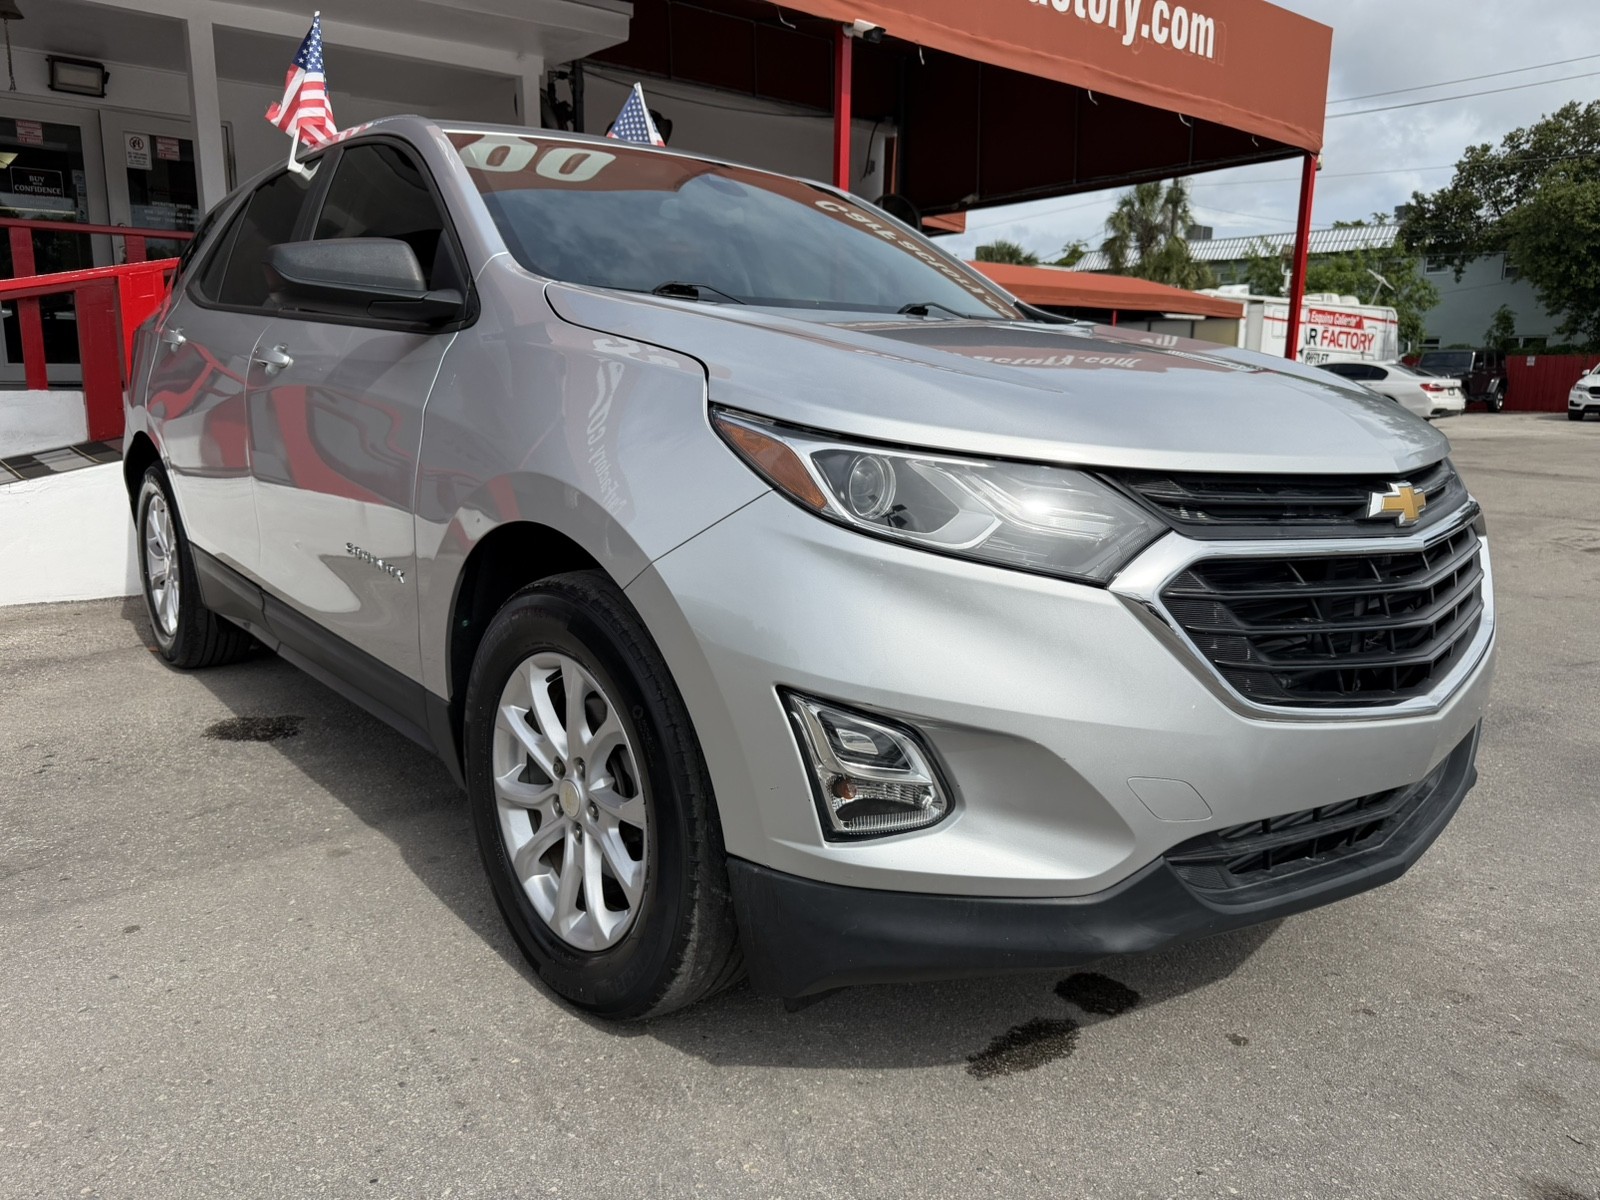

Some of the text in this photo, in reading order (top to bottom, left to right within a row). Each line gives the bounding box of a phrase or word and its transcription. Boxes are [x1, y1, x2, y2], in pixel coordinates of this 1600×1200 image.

[1028, 0, 1215, 59] ory.com
[29, 174, 45, 183] BUY
[14, 184, 62, 195] CONFIDENCE
[1320, 329, 1375, 351] FACTORY
